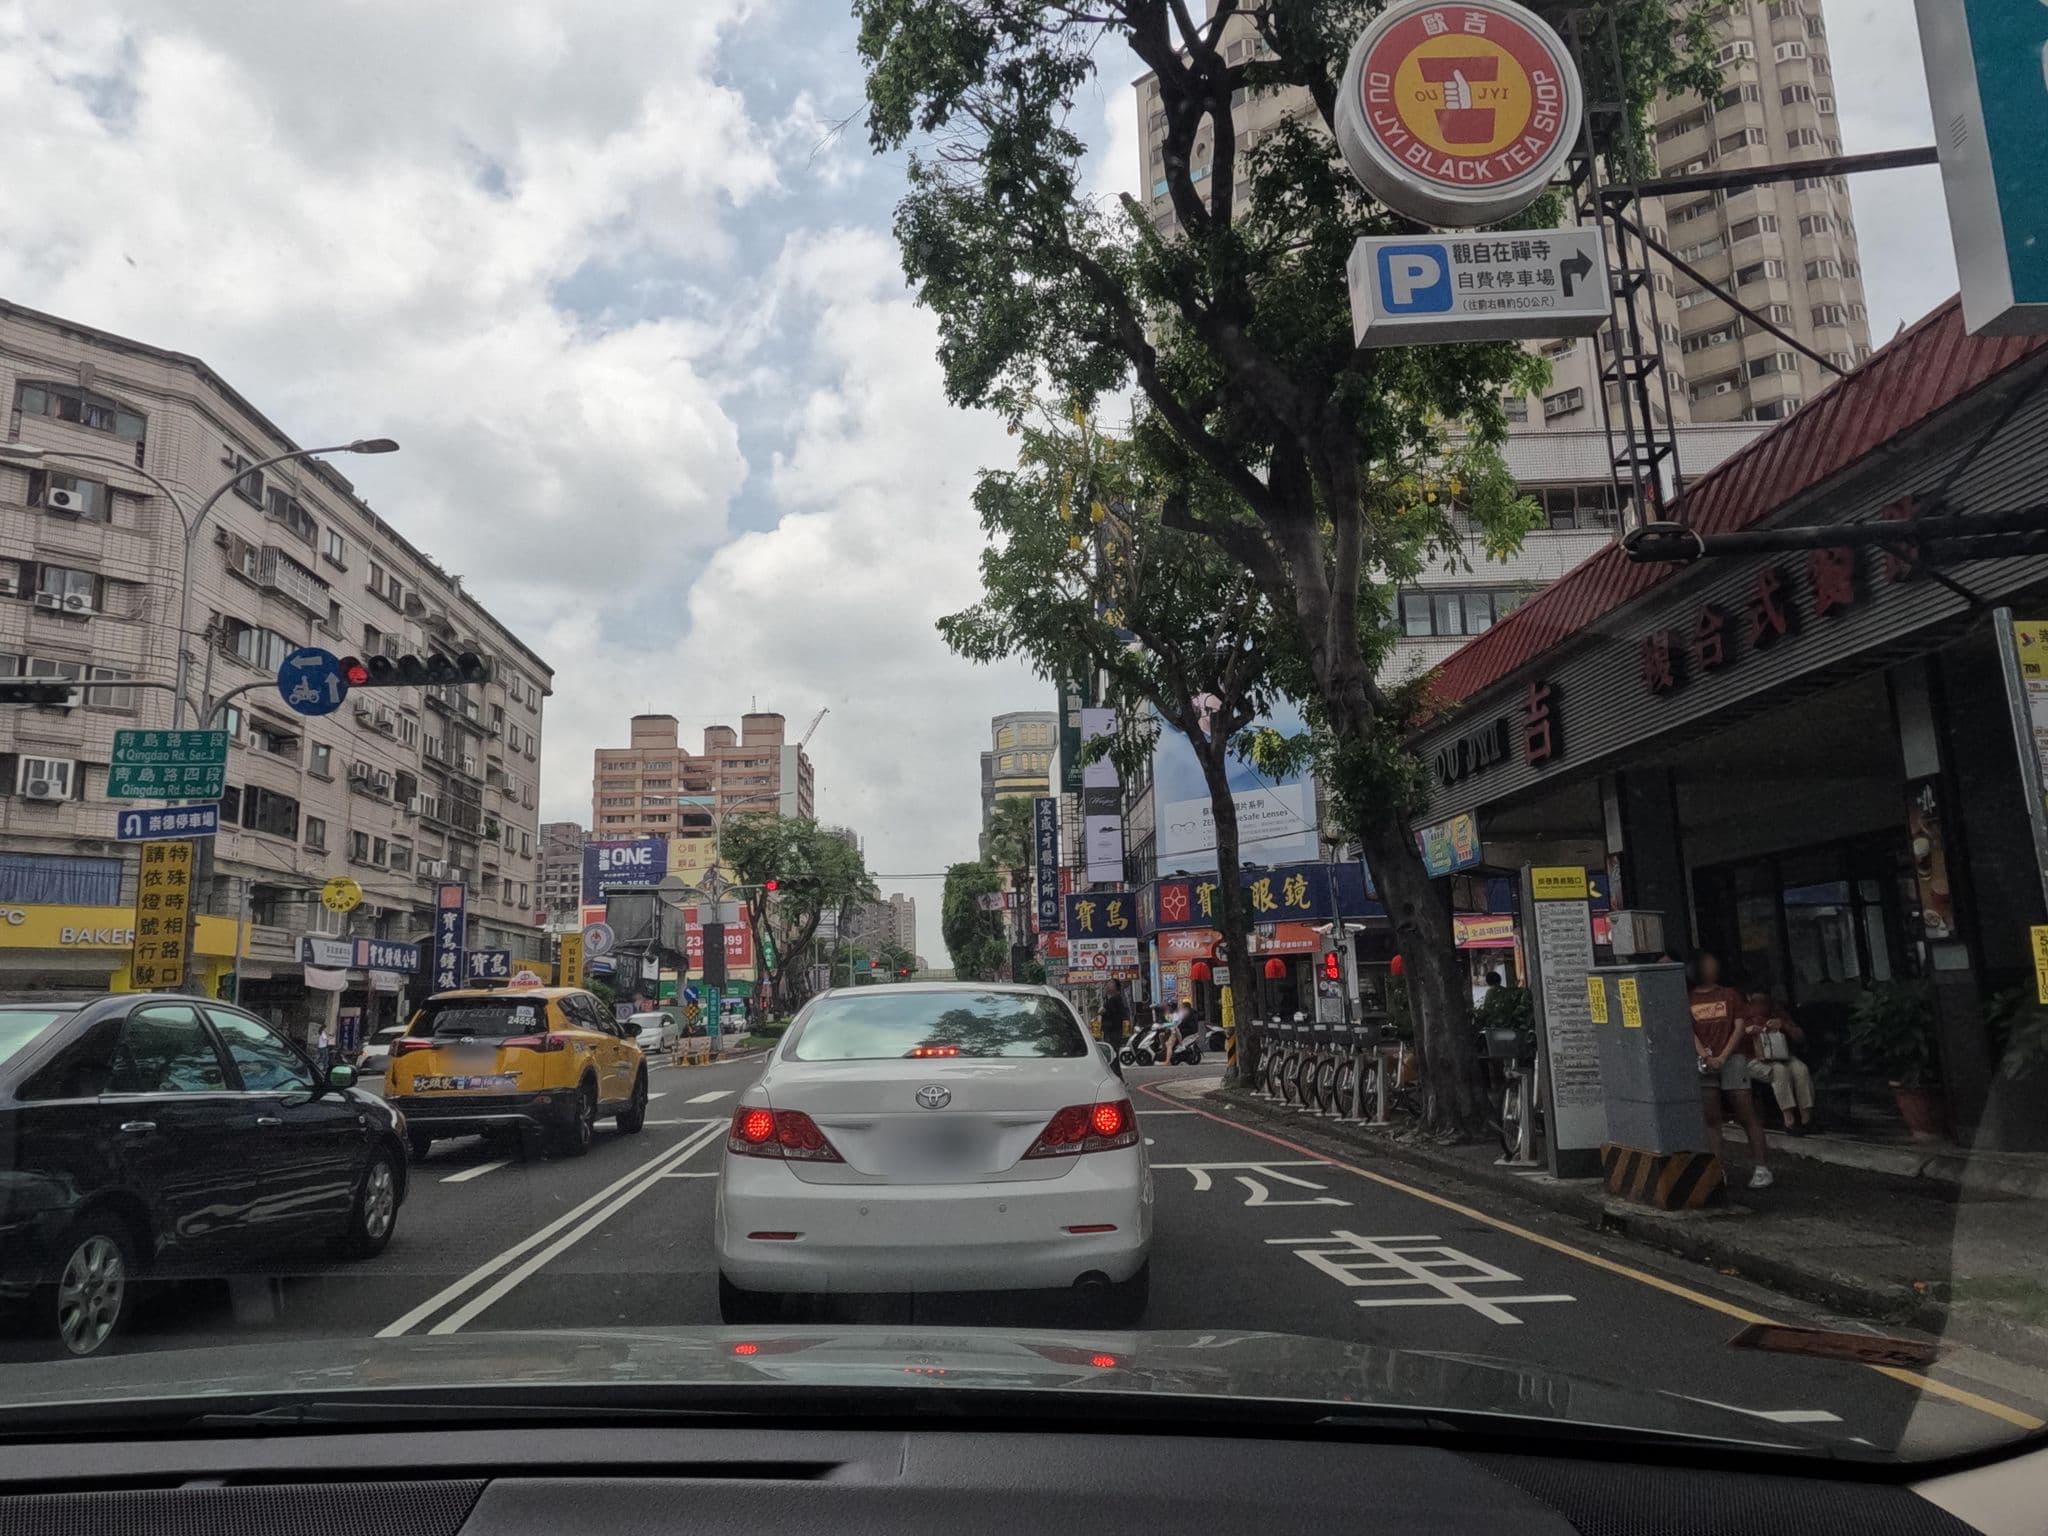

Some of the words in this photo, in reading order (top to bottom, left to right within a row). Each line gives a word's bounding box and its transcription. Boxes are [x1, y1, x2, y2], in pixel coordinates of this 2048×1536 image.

[1421, 12, 1488, 36] 歐吉
[1370, 72, 1390, 103] OU
[1415, 89, 1438, 102] OU
[1478, 87, 1509, 100] JYI
[1532, 70, 1558, 132] SHOP
[1374, 110, 1408, 149] JYI
[1404, 142, 1492, 181] BLACK
[1495, 140, 1545, 173] TEA
[1452, 240, 1551, 264] 觀自在禪寺
[1388, 253, 1441, 305] P
[1458, 269, 1555, 289] 自費停車場
[119, 732, 225, 748] 青島路三段
[126, 749, 170, 762] Qingdao
[172, 750, 185, 760] Rd.
[115, 767, 221, 782] 青島路四段
[121, 784, 166, 797] Qingdao
[168, 784, 181, 795] Rd.
[149, 811, 215, 832] 崇德停車場
[1262, 809, 1289, 820] Lenses
[611, 847, 652, 866] ONE
[1196, 873, 1311, 918] 寶眼鏡
[136, 845, 165, 985] 請依燈號行駛
[160, 845, 189, 983] 特殊時相路口
[1075, 900, 1128, 932] 寶島
[470, 953, 507, 976] 寶島
